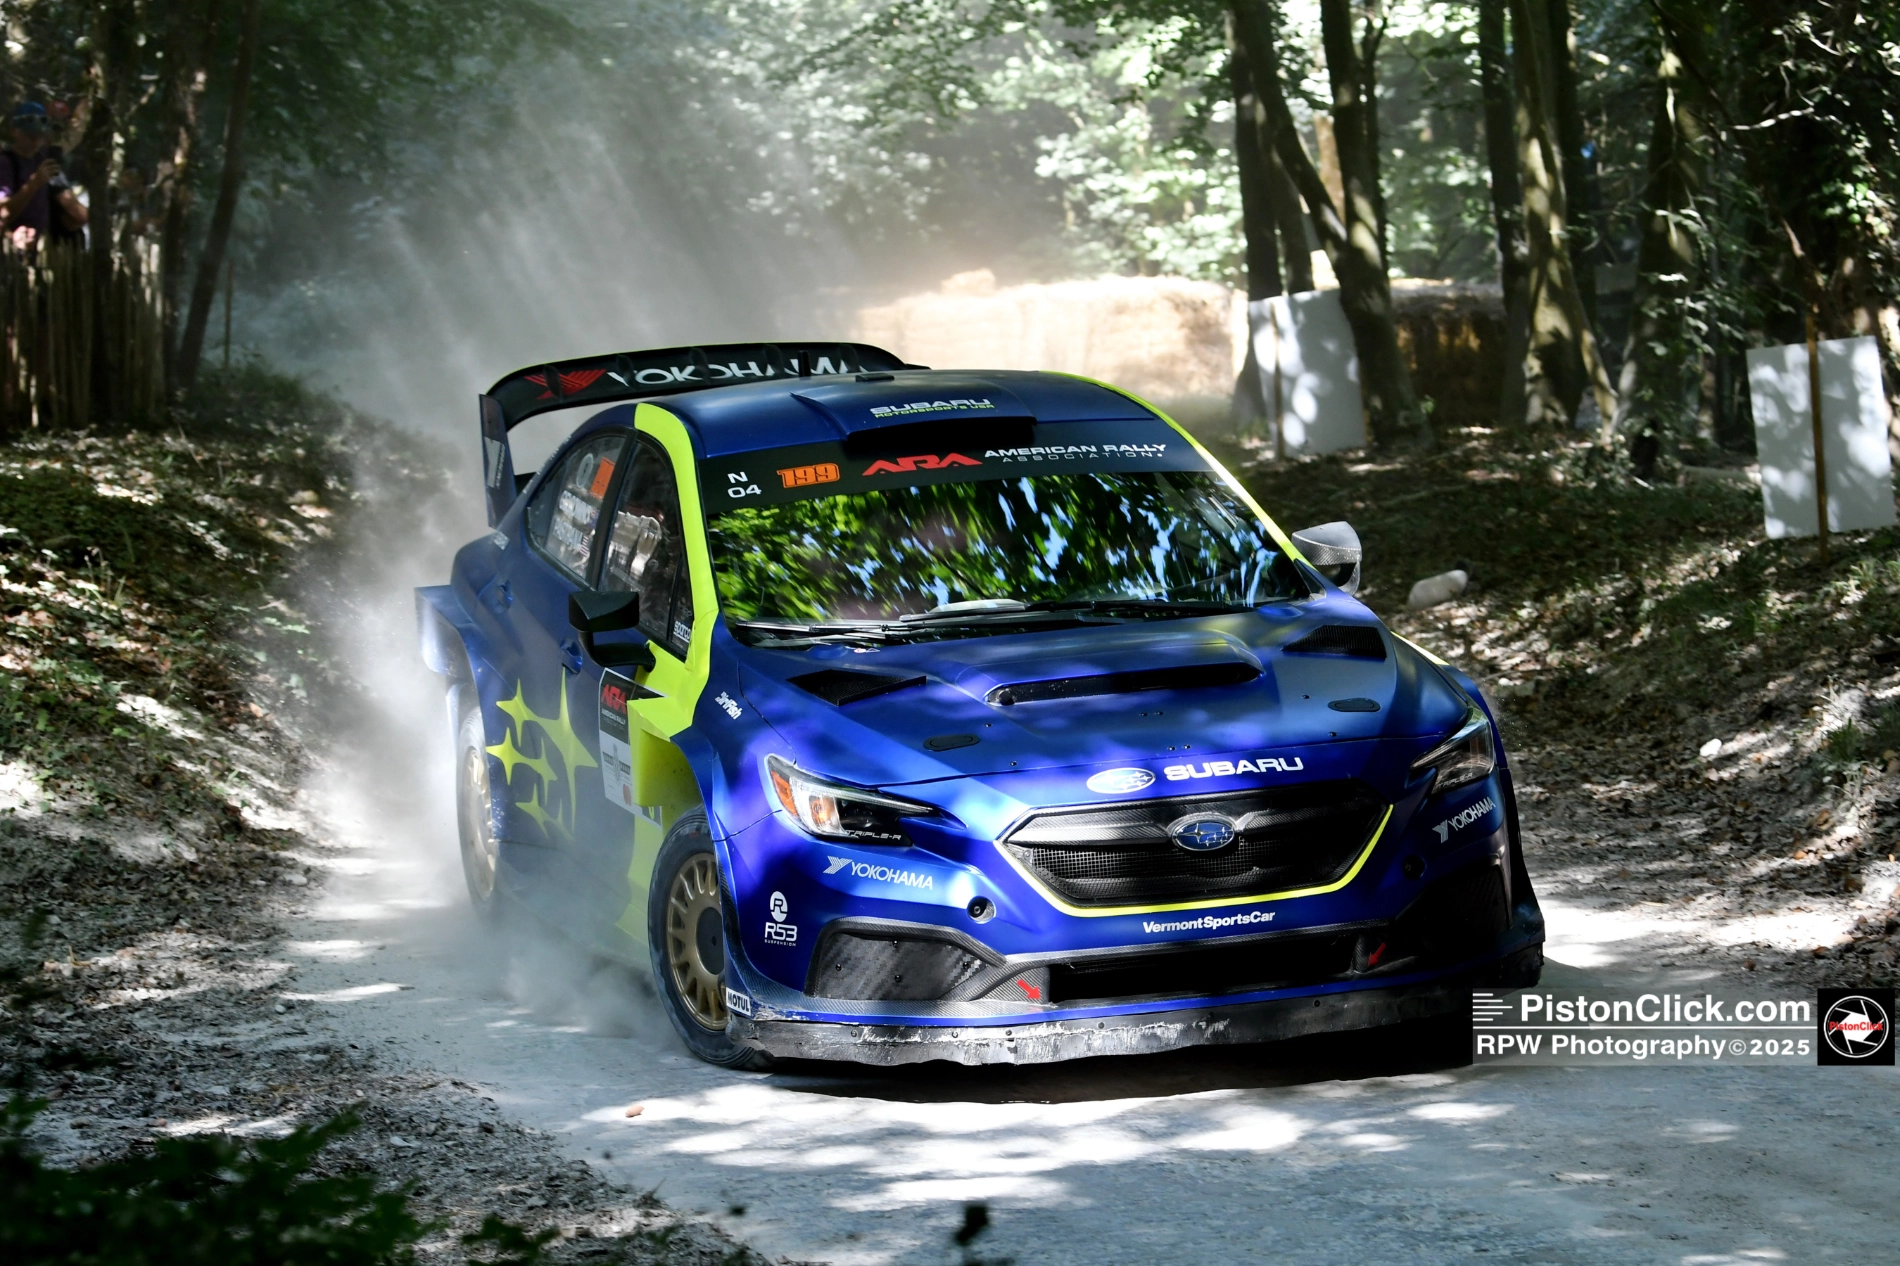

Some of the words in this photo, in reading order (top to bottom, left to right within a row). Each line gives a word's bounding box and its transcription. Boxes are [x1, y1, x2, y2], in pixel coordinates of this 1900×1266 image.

[870, 398, 991, 415] SUBARU
[875, 404, 968, 418] MOTORSPORTS
[862, 452, 983, 476] ARA
[984, 445, 1099, 458] AMERICAN
[1102, 444, 1167, 452] RALLY
[727, 471, 748, 484] N
[776, 463, 840, 489] 199
[727, 484, 762, 499] 04
[1163, 757, 1304, 781] SUBARU
[1447, 796, 1496, 831] YOKOHAMA
[845, 829, 902, 840] TRIPLE-R
[851, 861, 933, 890] YOKOHAMA
[764, 921, 798, 941] R53
[1142, 911, 1276, 933] VermontSportsCar
[764, 939, 797, 947] SUSPENSION
[727, 991, 750, 1013] MOTUL
